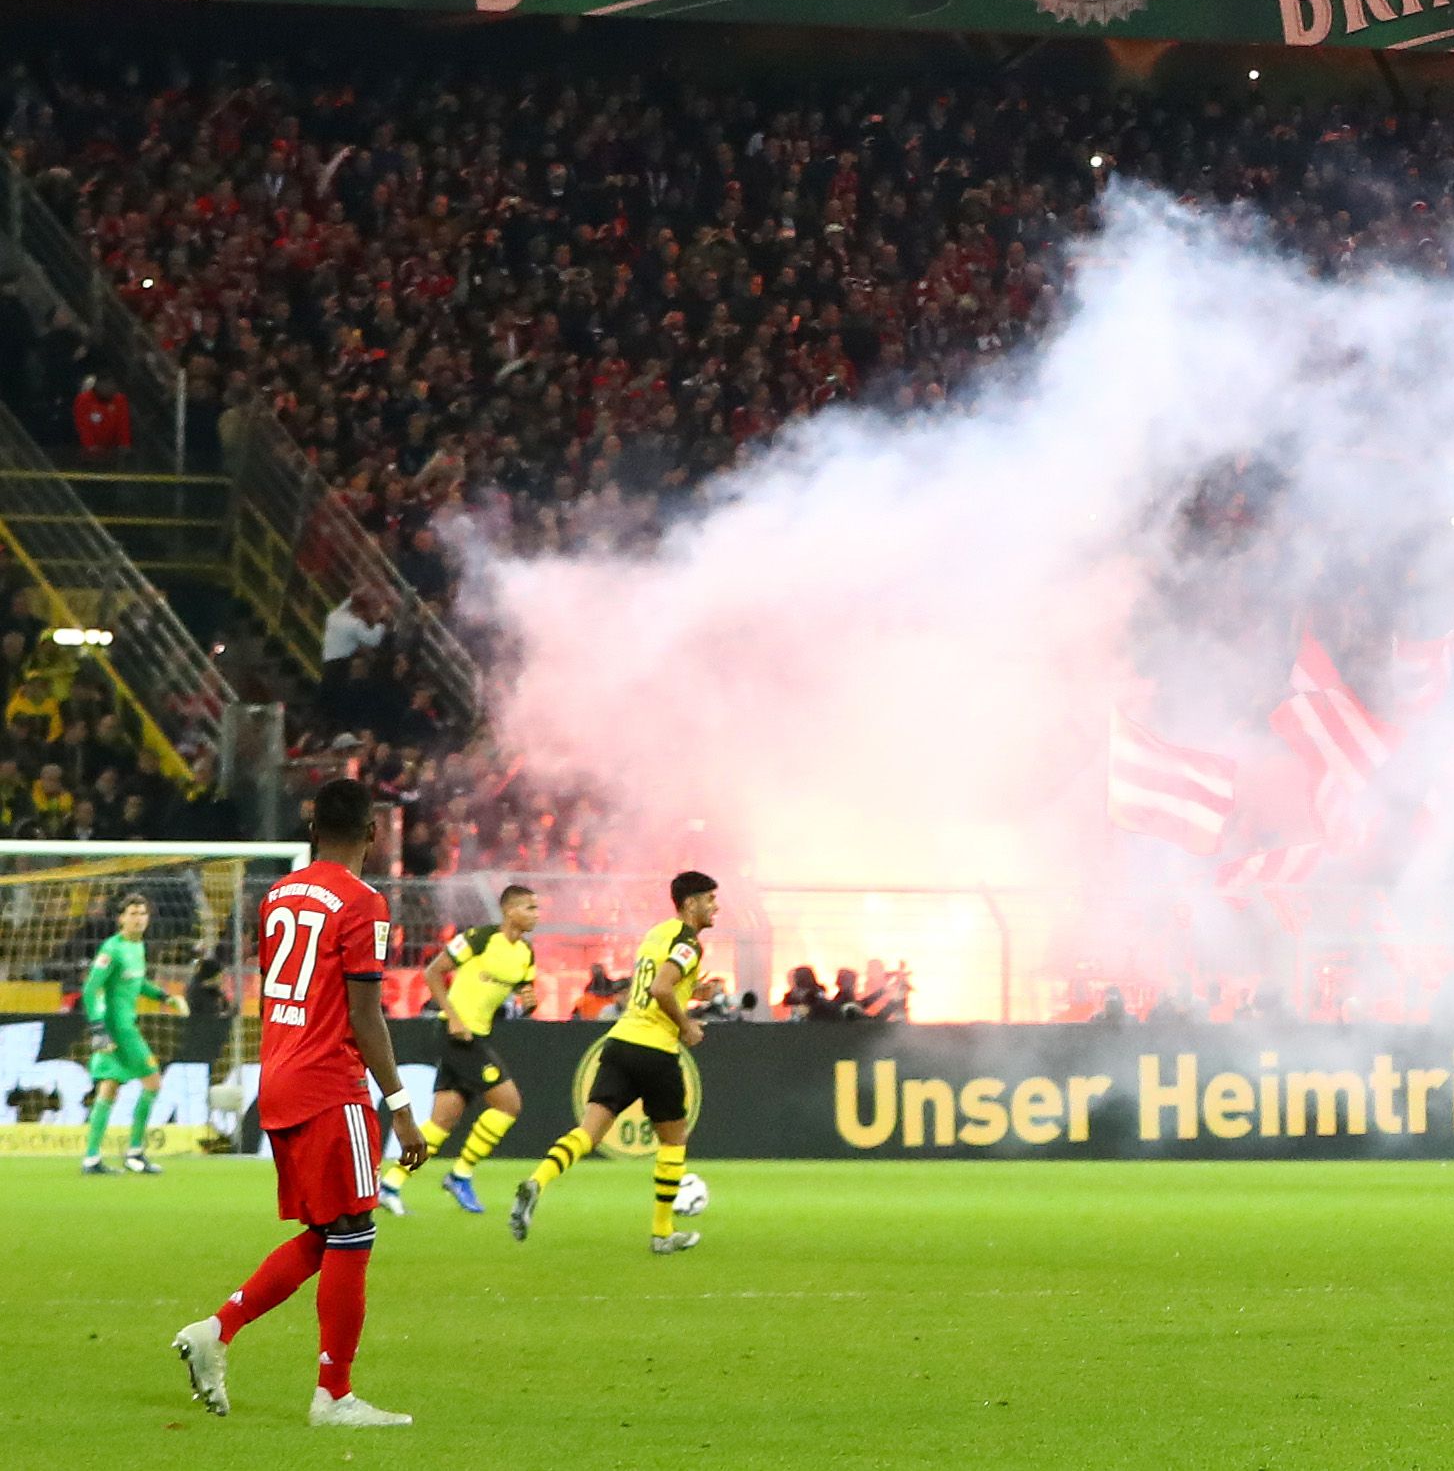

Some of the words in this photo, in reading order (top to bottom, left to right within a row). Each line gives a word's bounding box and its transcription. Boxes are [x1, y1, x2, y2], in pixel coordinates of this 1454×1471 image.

[264, 906, 326, 1001] 27
[270, 1003, 306, 1027] ALABA
[834, 1058, 1113, 1147] Unser
